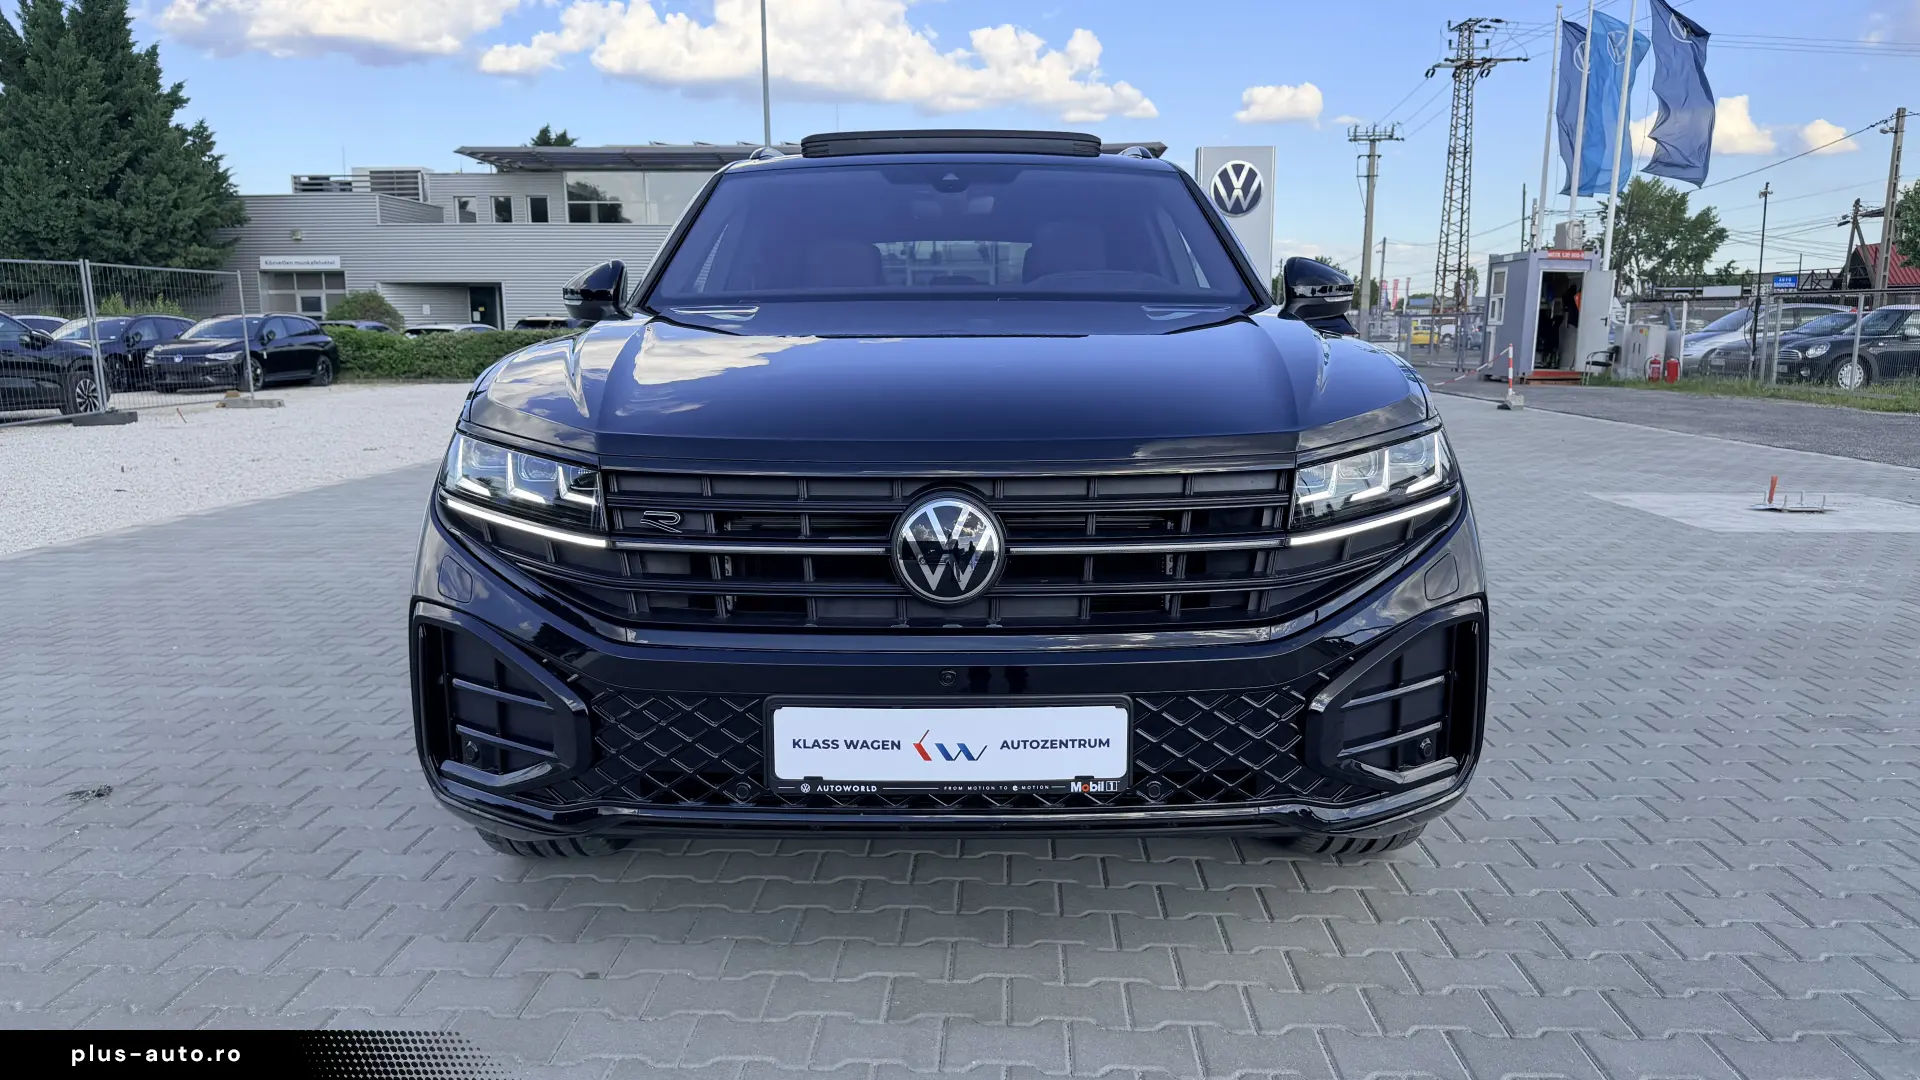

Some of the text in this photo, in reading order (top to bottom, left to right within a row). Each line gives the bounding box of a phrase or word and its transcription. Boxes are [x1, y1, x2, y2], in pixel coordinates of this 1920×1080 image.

[792, 738, 901, 750] KLASS WAGEN
[1000, 738, 1110, 750] AUTOZENTRUM
[816, 784, 878, 792] AUTOWORLD
[1070, 781, 1104, 792] Mobil
